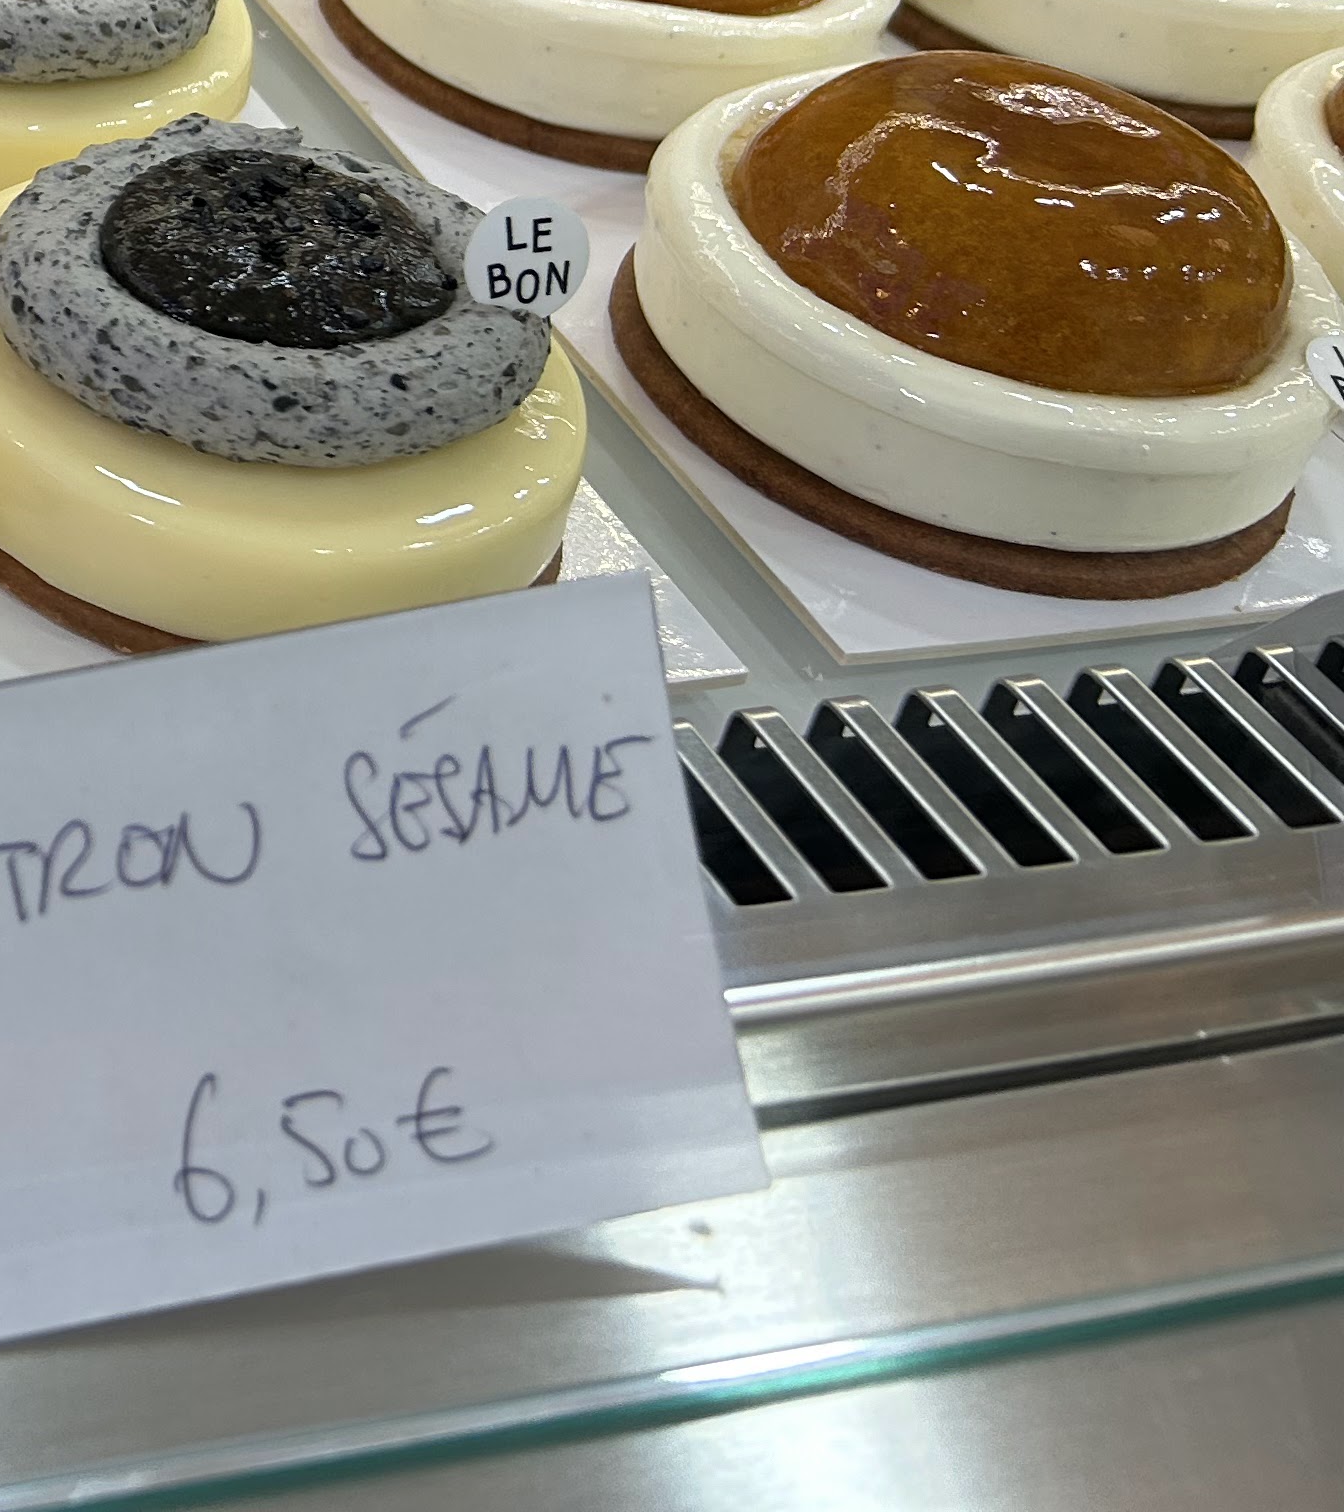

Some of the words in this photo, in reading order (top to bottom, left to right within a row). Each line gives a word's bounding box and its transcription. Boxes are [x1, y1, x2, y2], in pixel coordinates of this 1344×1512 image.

[504, 216, 553, 253] LE
[486, 260, 571, 304] BON
[173, 1064, 494, 1228] 6,50€
